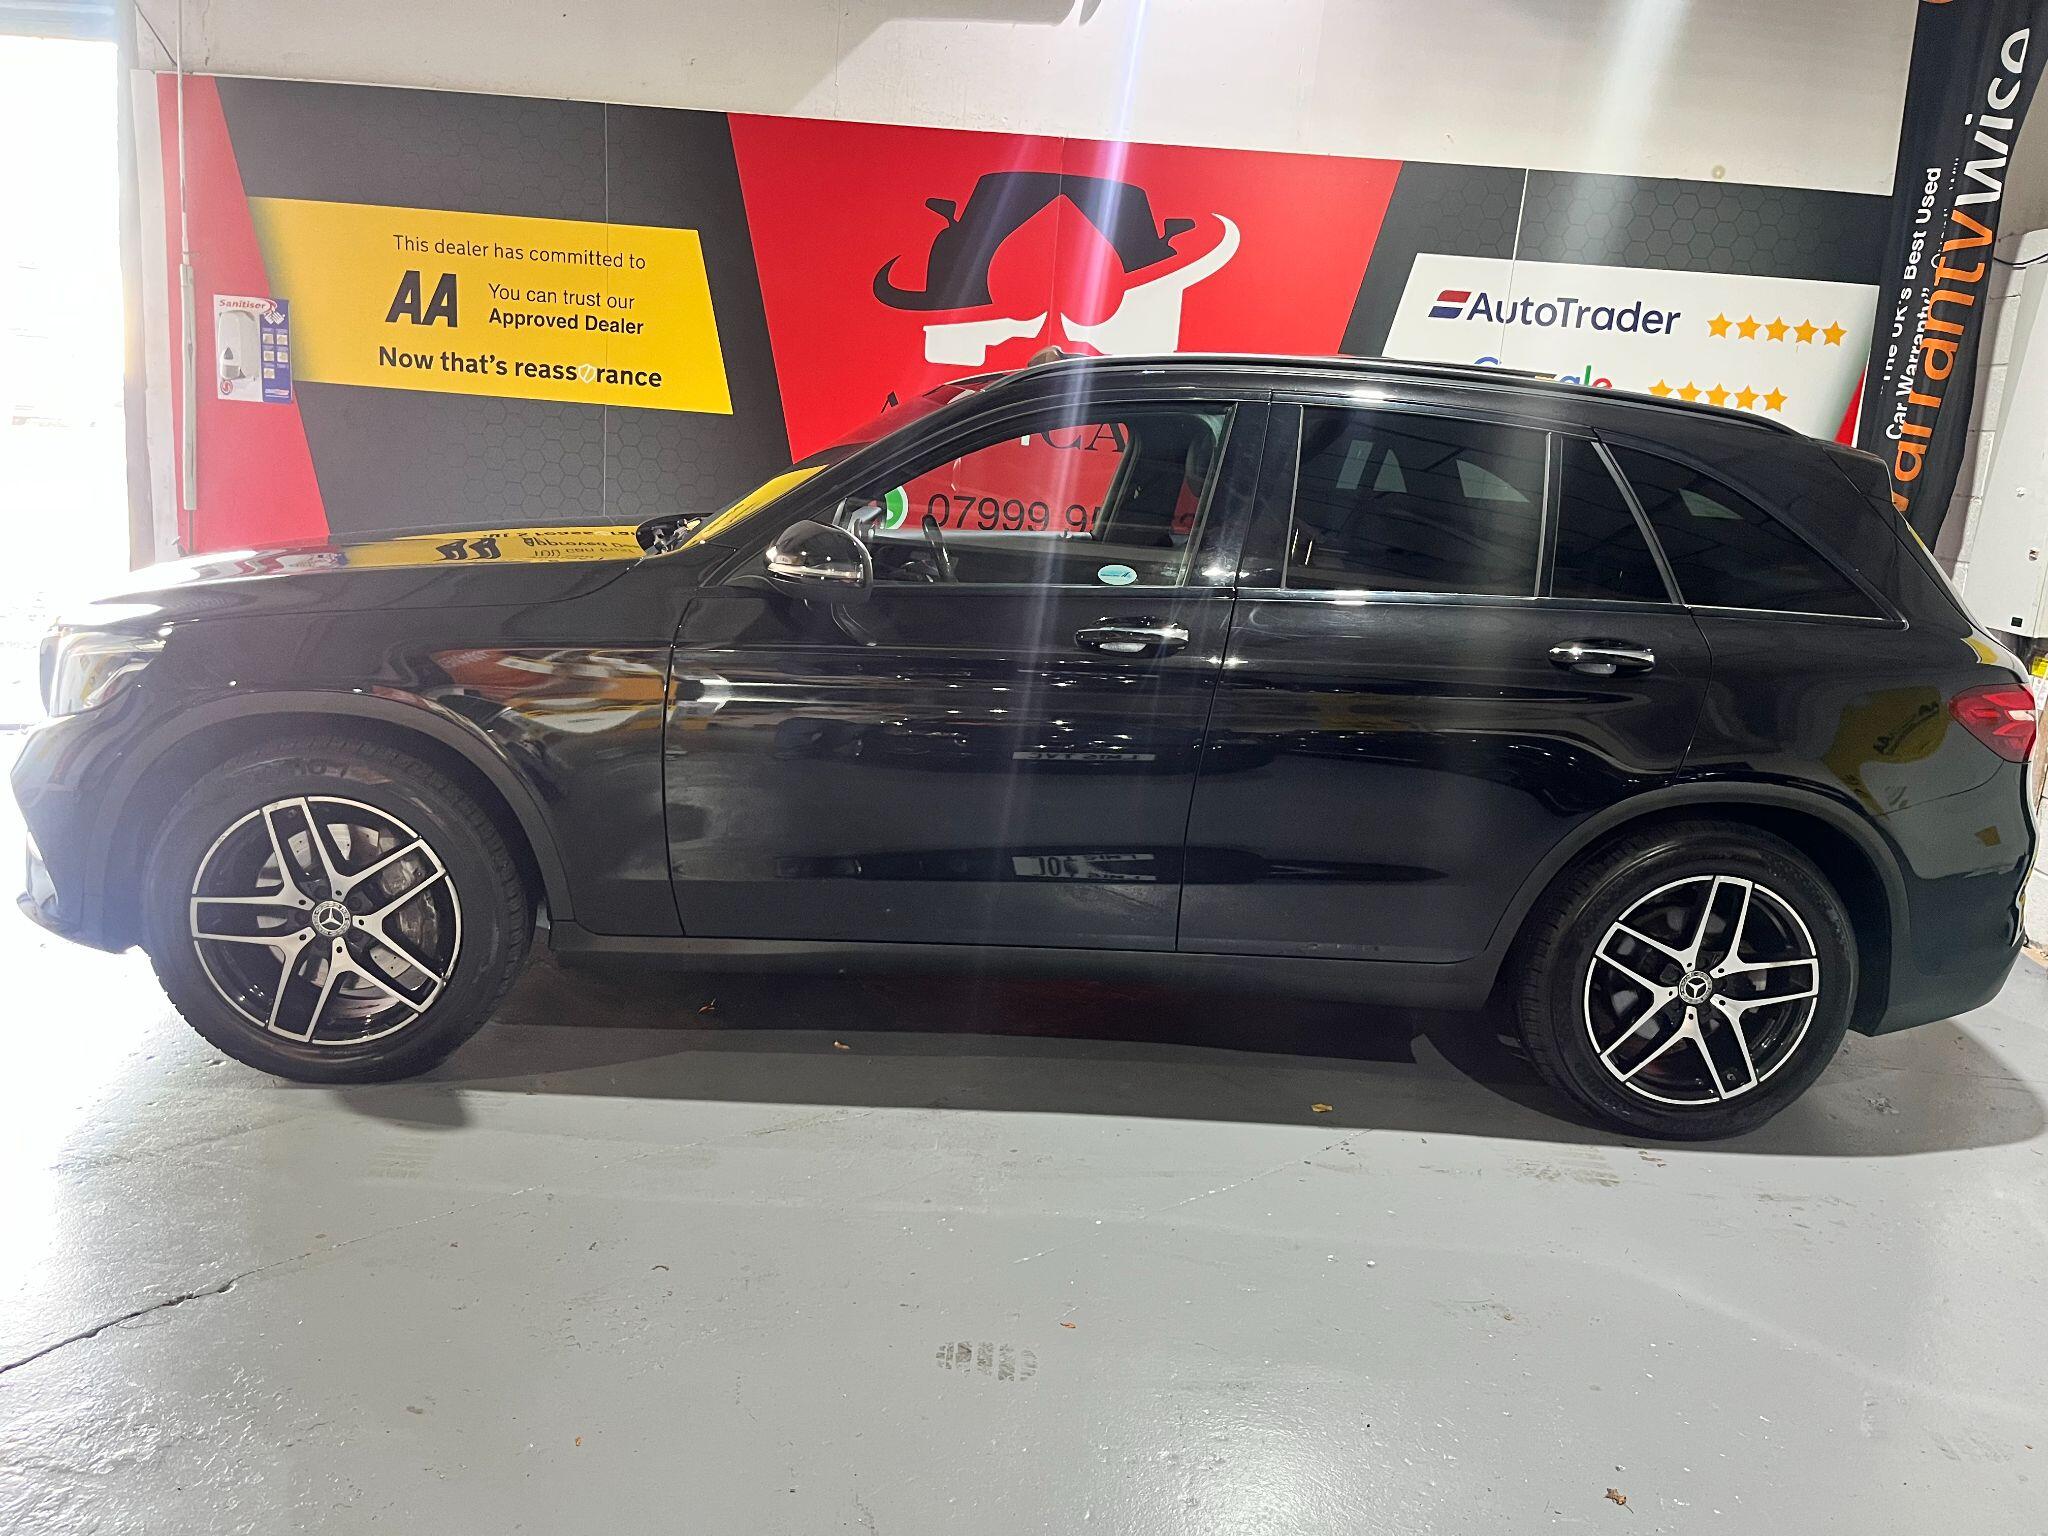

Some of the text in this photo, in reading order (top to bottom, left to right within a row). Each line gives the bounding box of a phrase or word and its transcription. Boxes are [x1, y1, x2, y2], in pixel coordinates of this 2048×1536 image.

[1904, 230, 1927, 280] Best
[1916, 167, 1942, 224] Used
[393, 234, 646, 269] This dealer has committed to
[219, 299, 267, 310] Sanitiser
[385, 269, 458, 328] AA
[488, 282, 635, 310] You can trust our
[1467, 292, 1682, 335] AutoTrader
[489, 307, 644, 335] Approved Dealer
[379, 345, 434, 370] Now
[1885, 401, 1908, 440] Car
[927, 493, 1050, 532] 07999
